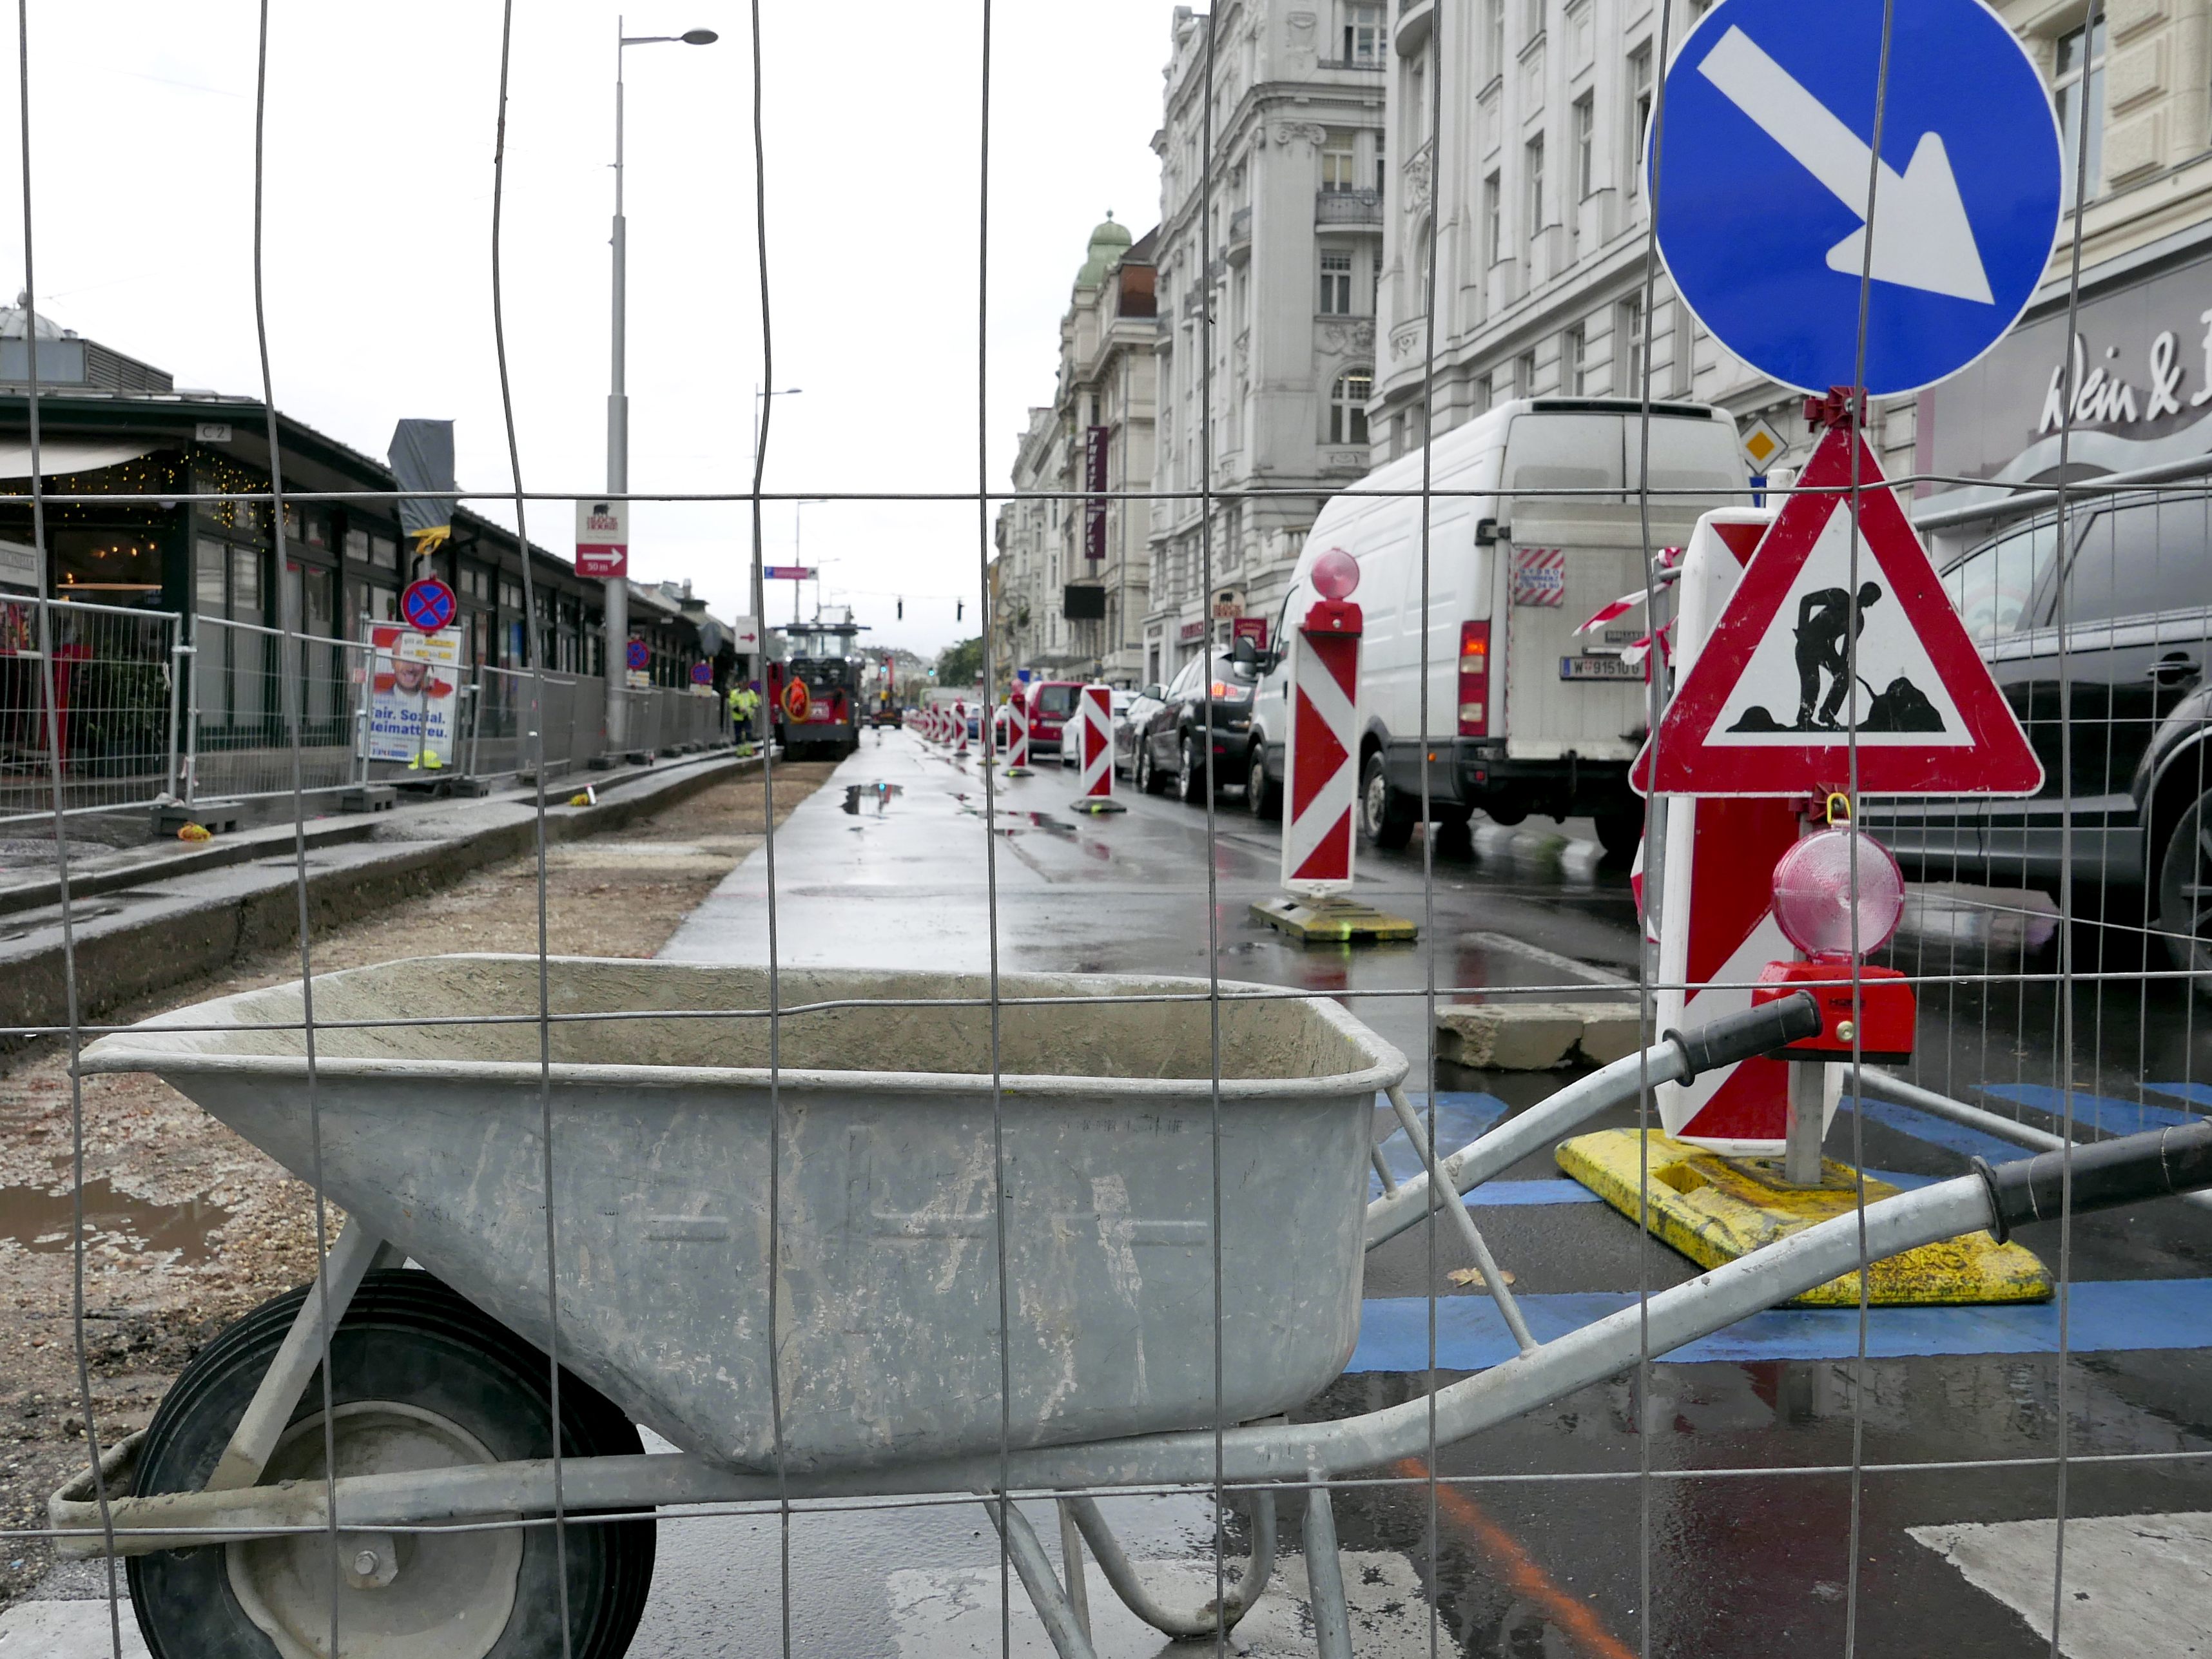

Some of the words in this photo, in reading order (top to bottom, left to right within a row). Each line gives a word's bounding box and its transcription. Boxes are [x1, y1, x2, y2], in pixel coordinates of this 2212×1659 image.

[2146, 330, 2181, 422] &
[1575, 661, 1583, 674] W
[373, 706, 396, 720] air.
[371, 721, 447, 738] eimatteu.
